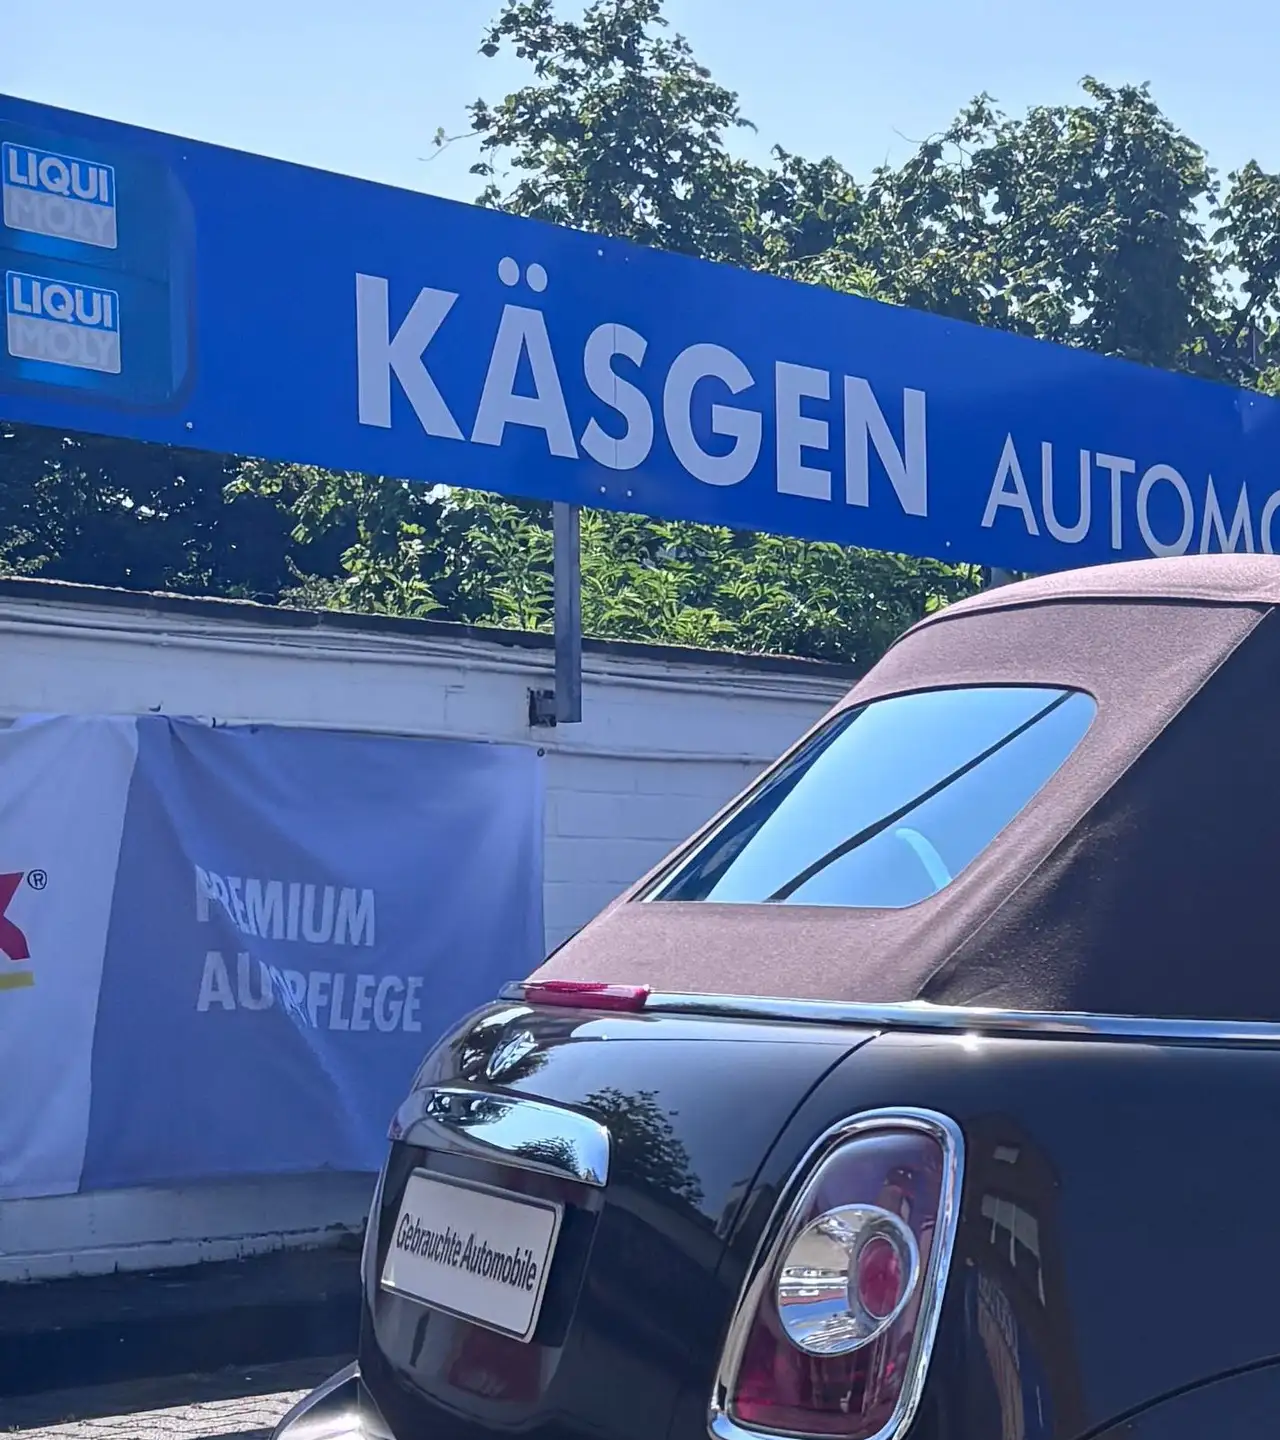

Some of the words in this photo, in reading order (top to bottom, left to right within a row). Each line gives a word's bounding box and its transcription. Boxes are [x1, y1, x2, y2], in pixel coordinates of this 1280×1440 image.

[9, 148, 108, 202] LIQUI
[10, 193, 111, 241] MOLY
[13, 277, 112, 328] LIQUI
[14, 322, 113, 367] MOLY
[355, 256, 928, 517] KÄSGEN
[194, 864, 376, 946] PREMIUM
[396, 1212, 463, 1267] Gebrauchte
[461, 1233, 538, 1291] Automobile
